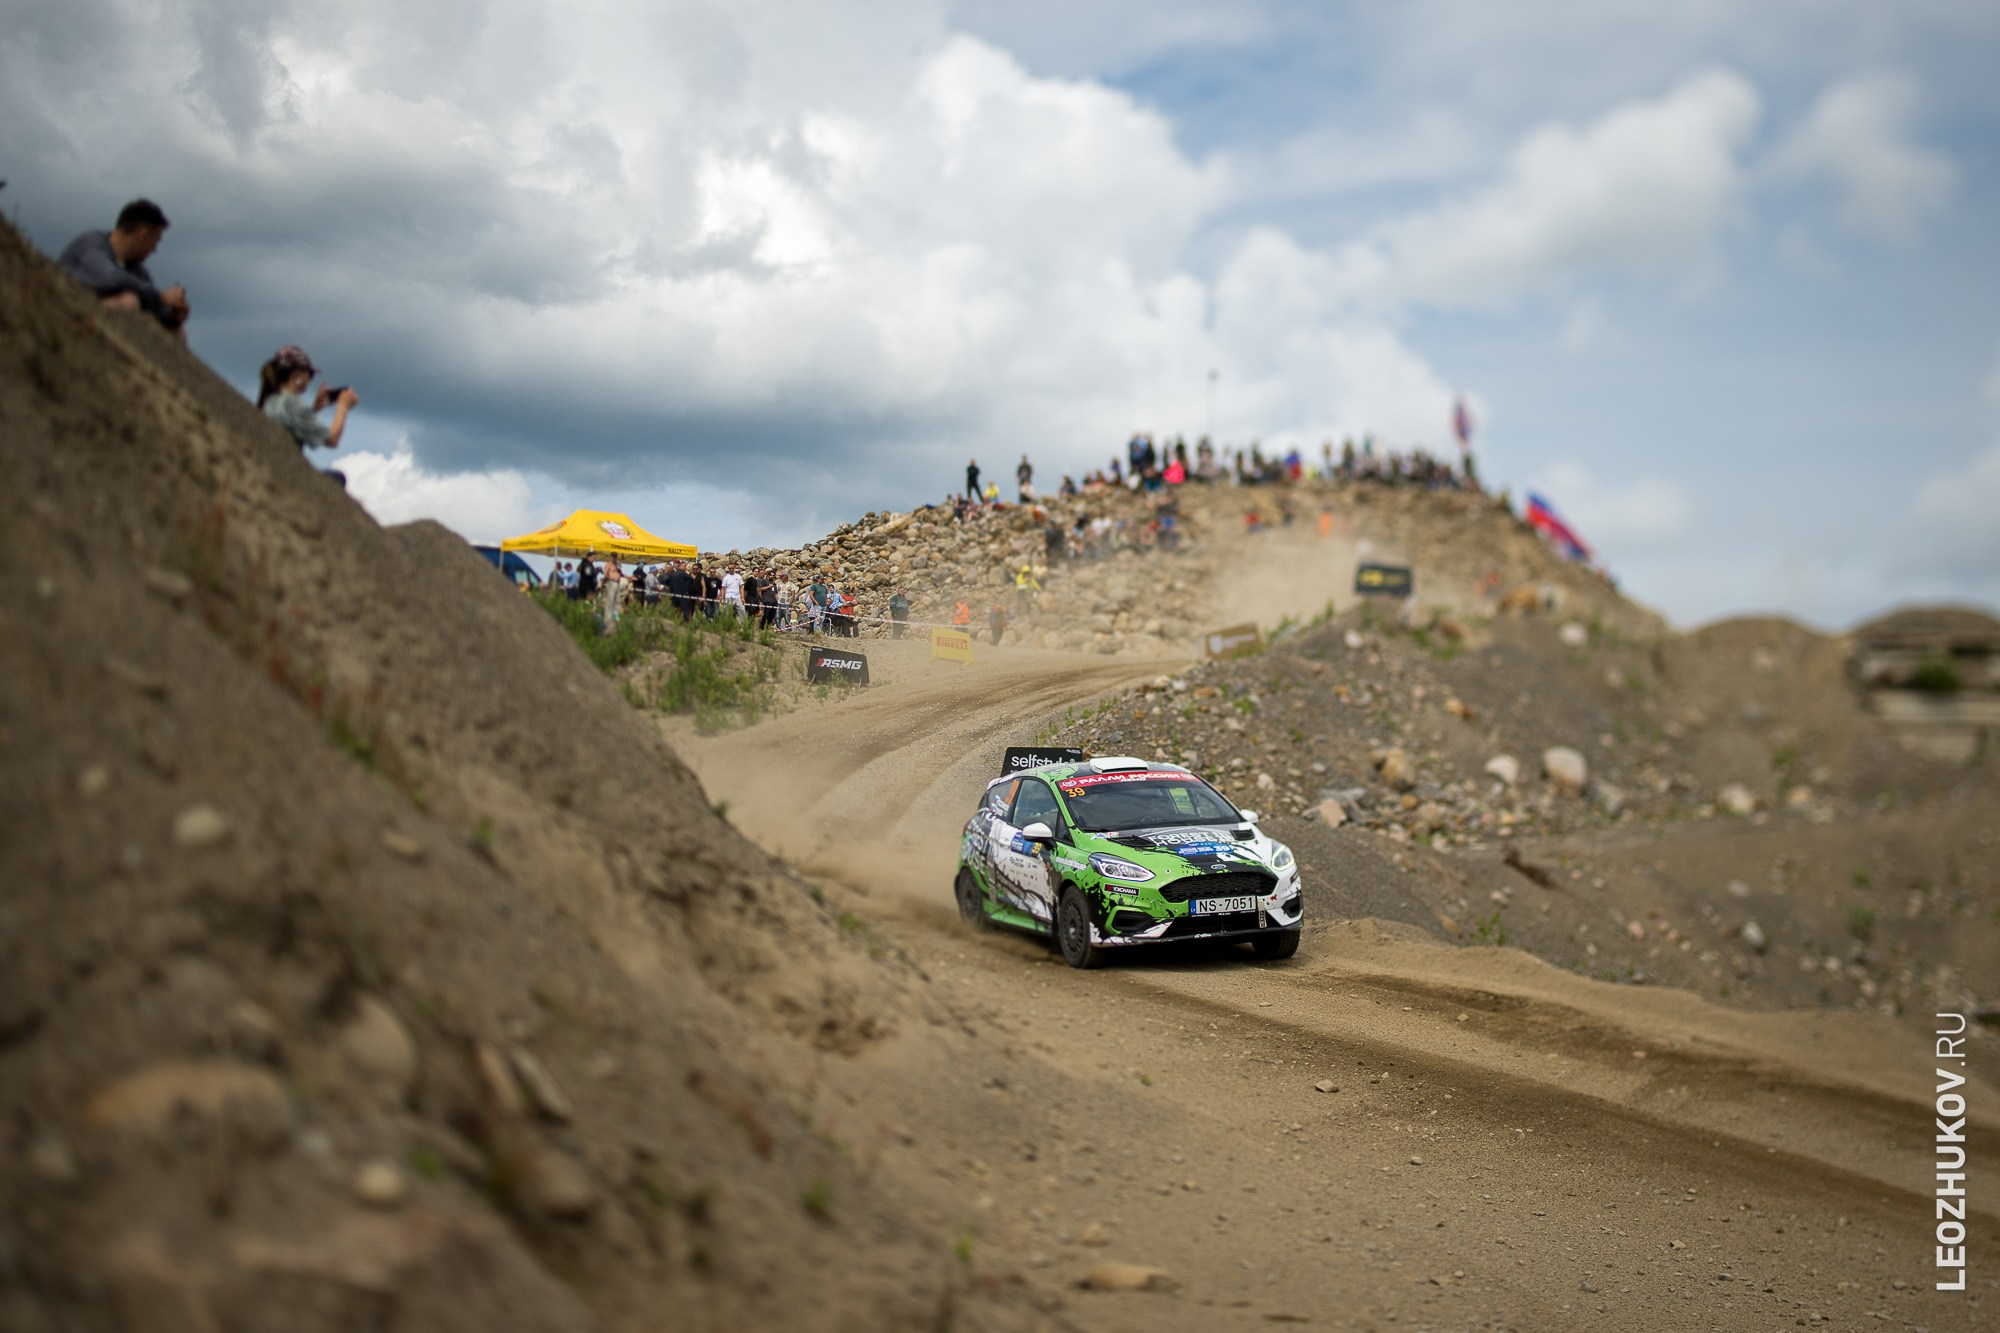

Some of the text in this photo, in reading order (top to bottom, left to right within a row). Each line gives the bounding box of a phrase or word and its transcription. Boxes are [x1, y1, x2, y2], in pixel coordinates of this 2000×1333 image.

[1079, 775, 1126, 784] РАЛЛИ
[1065, 786, 1086, 798] 39
[1113, 886, 1137, 895] YOKOHAMA
